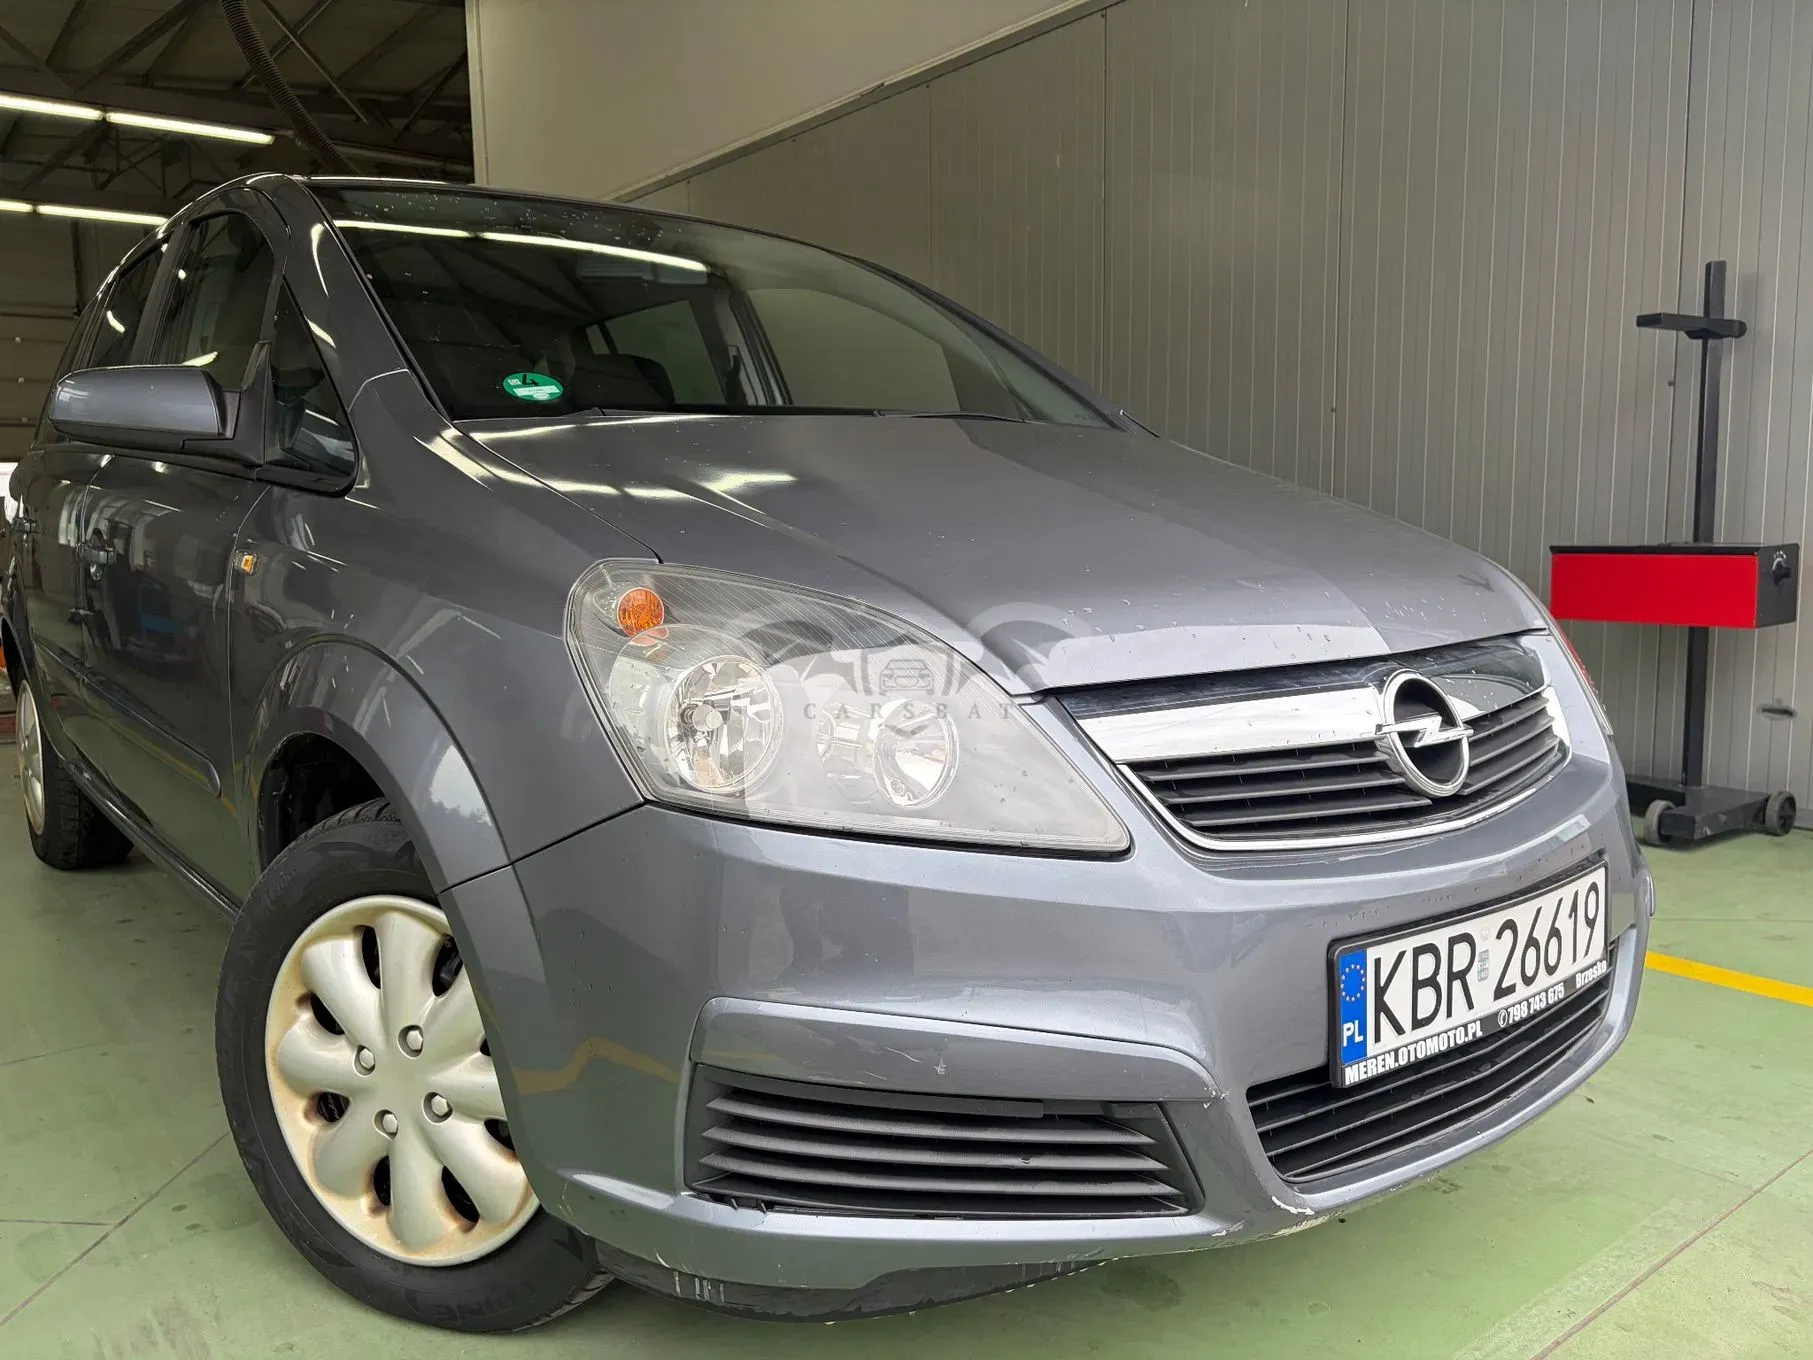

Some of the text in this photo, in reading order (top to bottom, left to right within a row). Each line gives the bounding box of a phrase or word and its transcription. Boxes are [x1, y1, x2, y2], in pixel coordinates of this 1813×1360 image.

[1345, 960, 1607, 1086] MEREN.OTOMOTO.PL 798 743 675 Brzesko
[1374, 881, 1599, 1044] KBR 26619
[1343, 1020, 1363, 1047] PL
